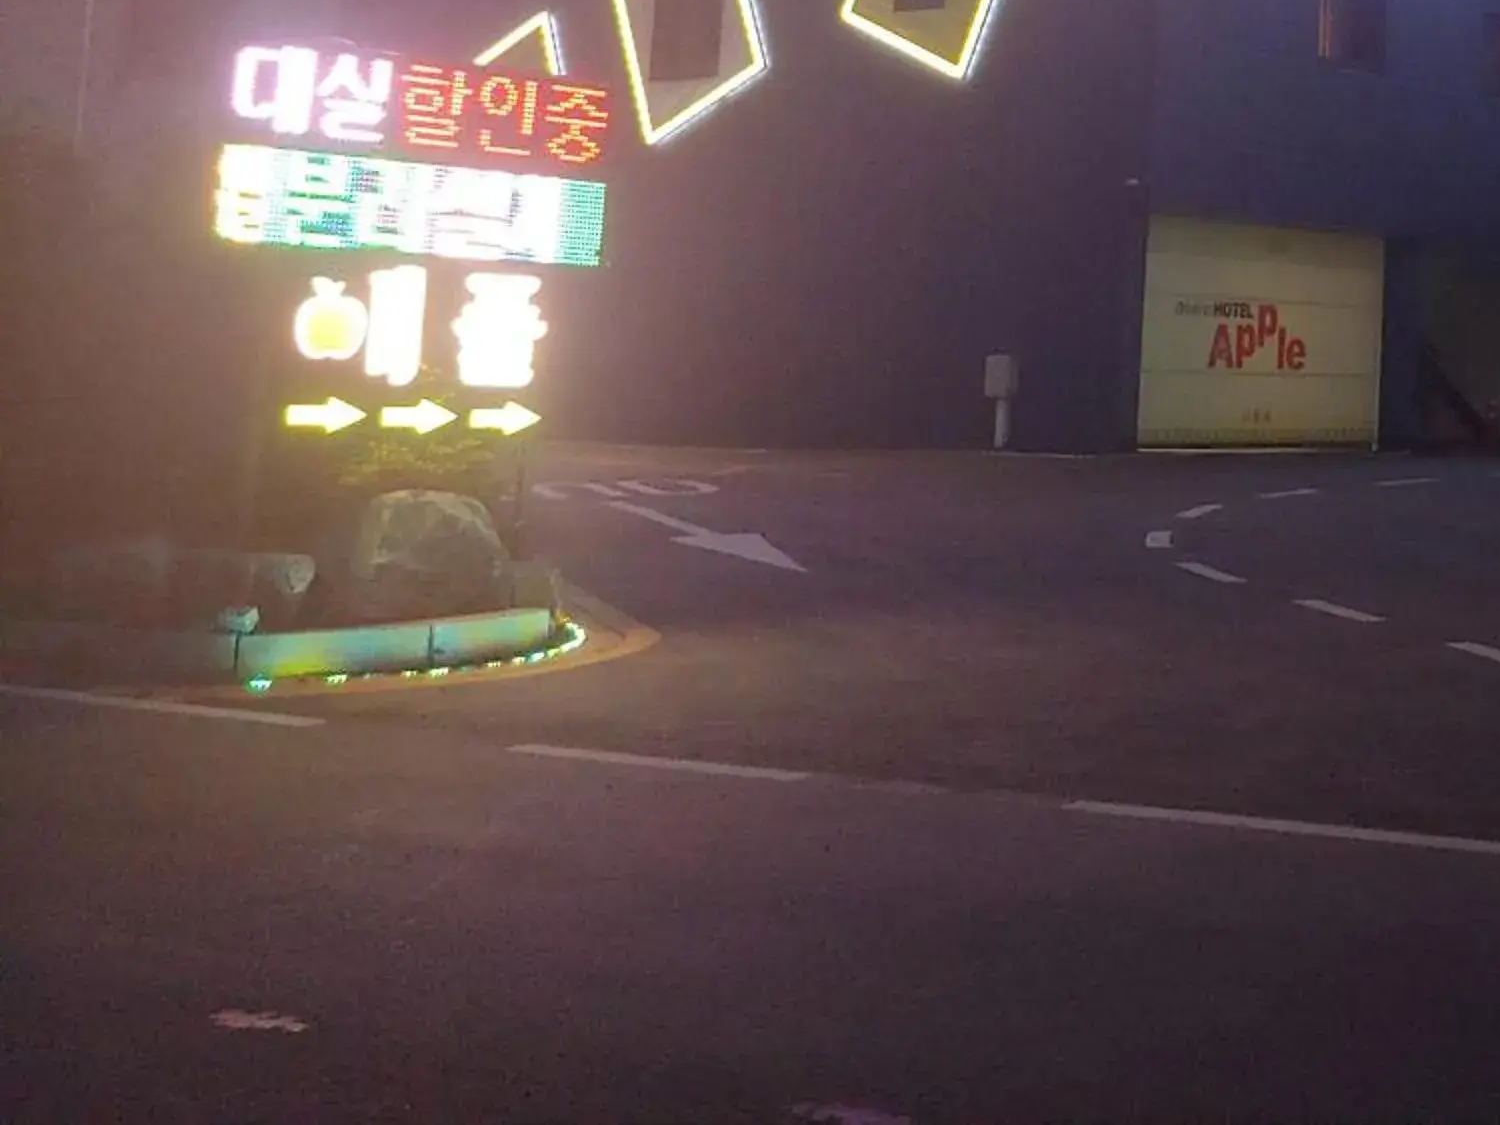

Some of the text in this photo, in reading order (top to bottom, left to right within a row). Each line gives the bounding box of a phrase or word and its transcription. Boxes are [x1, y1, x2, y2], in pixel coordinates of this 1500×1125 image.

[231, 45, 609, 165] 대실 할인중
[1213, 302, 1254, 319] HOTEL
